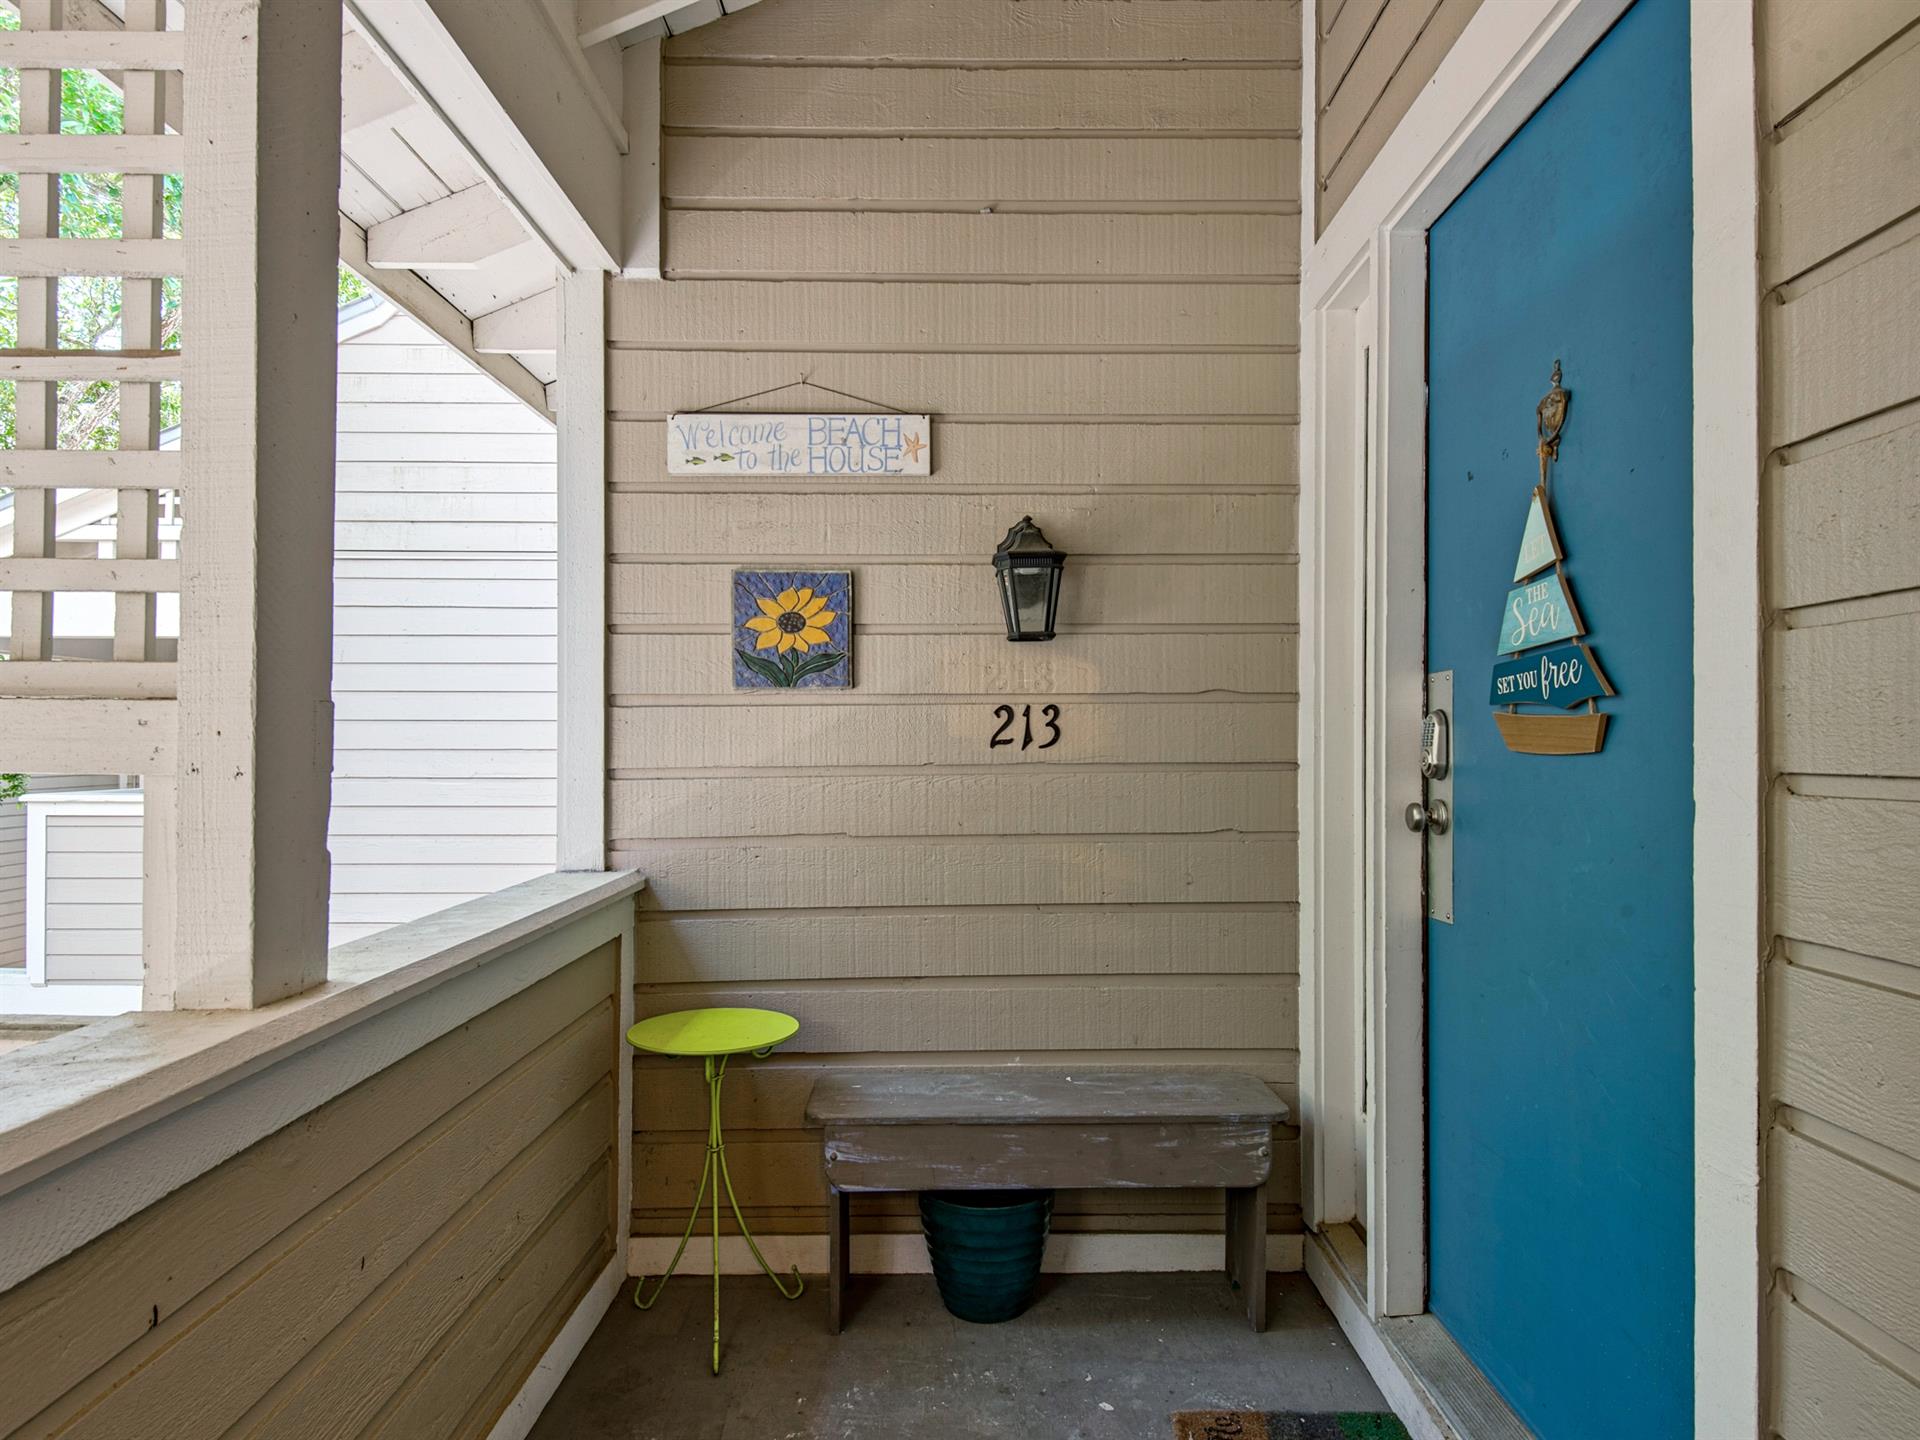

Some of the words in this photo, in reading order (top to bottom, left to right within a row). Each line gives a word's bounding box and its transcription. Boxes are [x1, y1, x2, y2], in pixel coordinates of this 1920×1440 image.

[676, 419, 786, 450] Welcome
[807, 417, 903, 446] BEACH
[734, 450, 757, 470] to
[768, 444, 801, 473] the
[807, 446, 903, 474] HOUSE
[1525, 582, 1549, 605] THE
[1511, 597, 1561, 647] Sea
[1497, 674, 1516, 695] SET
[1516, 670, 1538, 690] YOU
[1540, 655, 1583, 700] free
[989, 704, 1061, 751] 213
